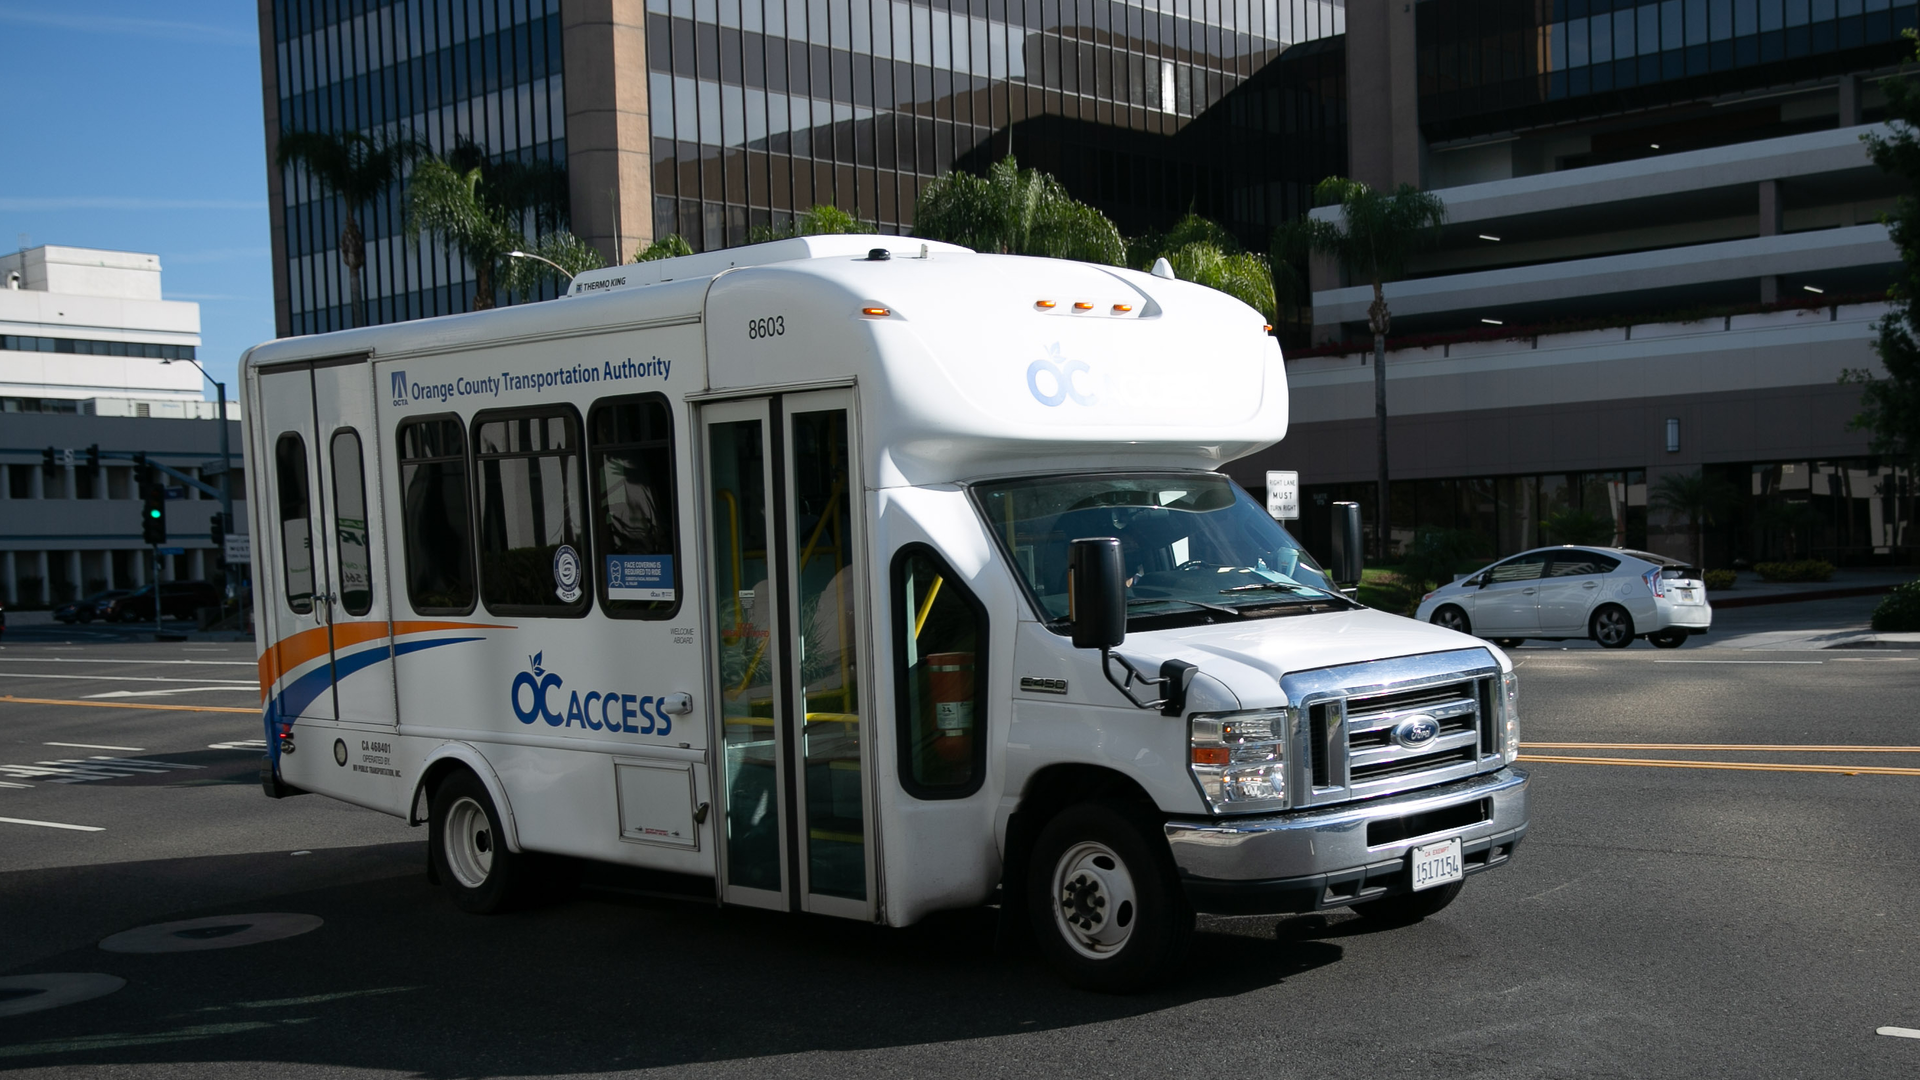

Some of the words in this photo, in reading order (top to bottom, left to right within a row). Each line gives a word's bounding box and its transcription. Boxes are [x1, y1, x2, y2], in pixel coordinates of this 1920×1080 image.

[584, 280, 610, 291] THERMO
[610, 277, 626, 287] KING
[748, 315, 785, 339] 8603
[411, 382, 454, 402] Orange
[456, 375, 500, 397] County
[502, 364, 600, 392] Transportation
[603, 356, 671, 381] Authority
[670, 627, 694, 635] WELCOME
[673, 636, 693, 644] ABOARD
[511, 671, 564, 727] OC
[565, 690, 672, 736] ACCESS
[1411, 723, 1431, 740] Ford
[361, 740, 369, 751] CA
[362, 754, 383, 765] OPERATED
[1416, 855, 1459, 882] 1517154
